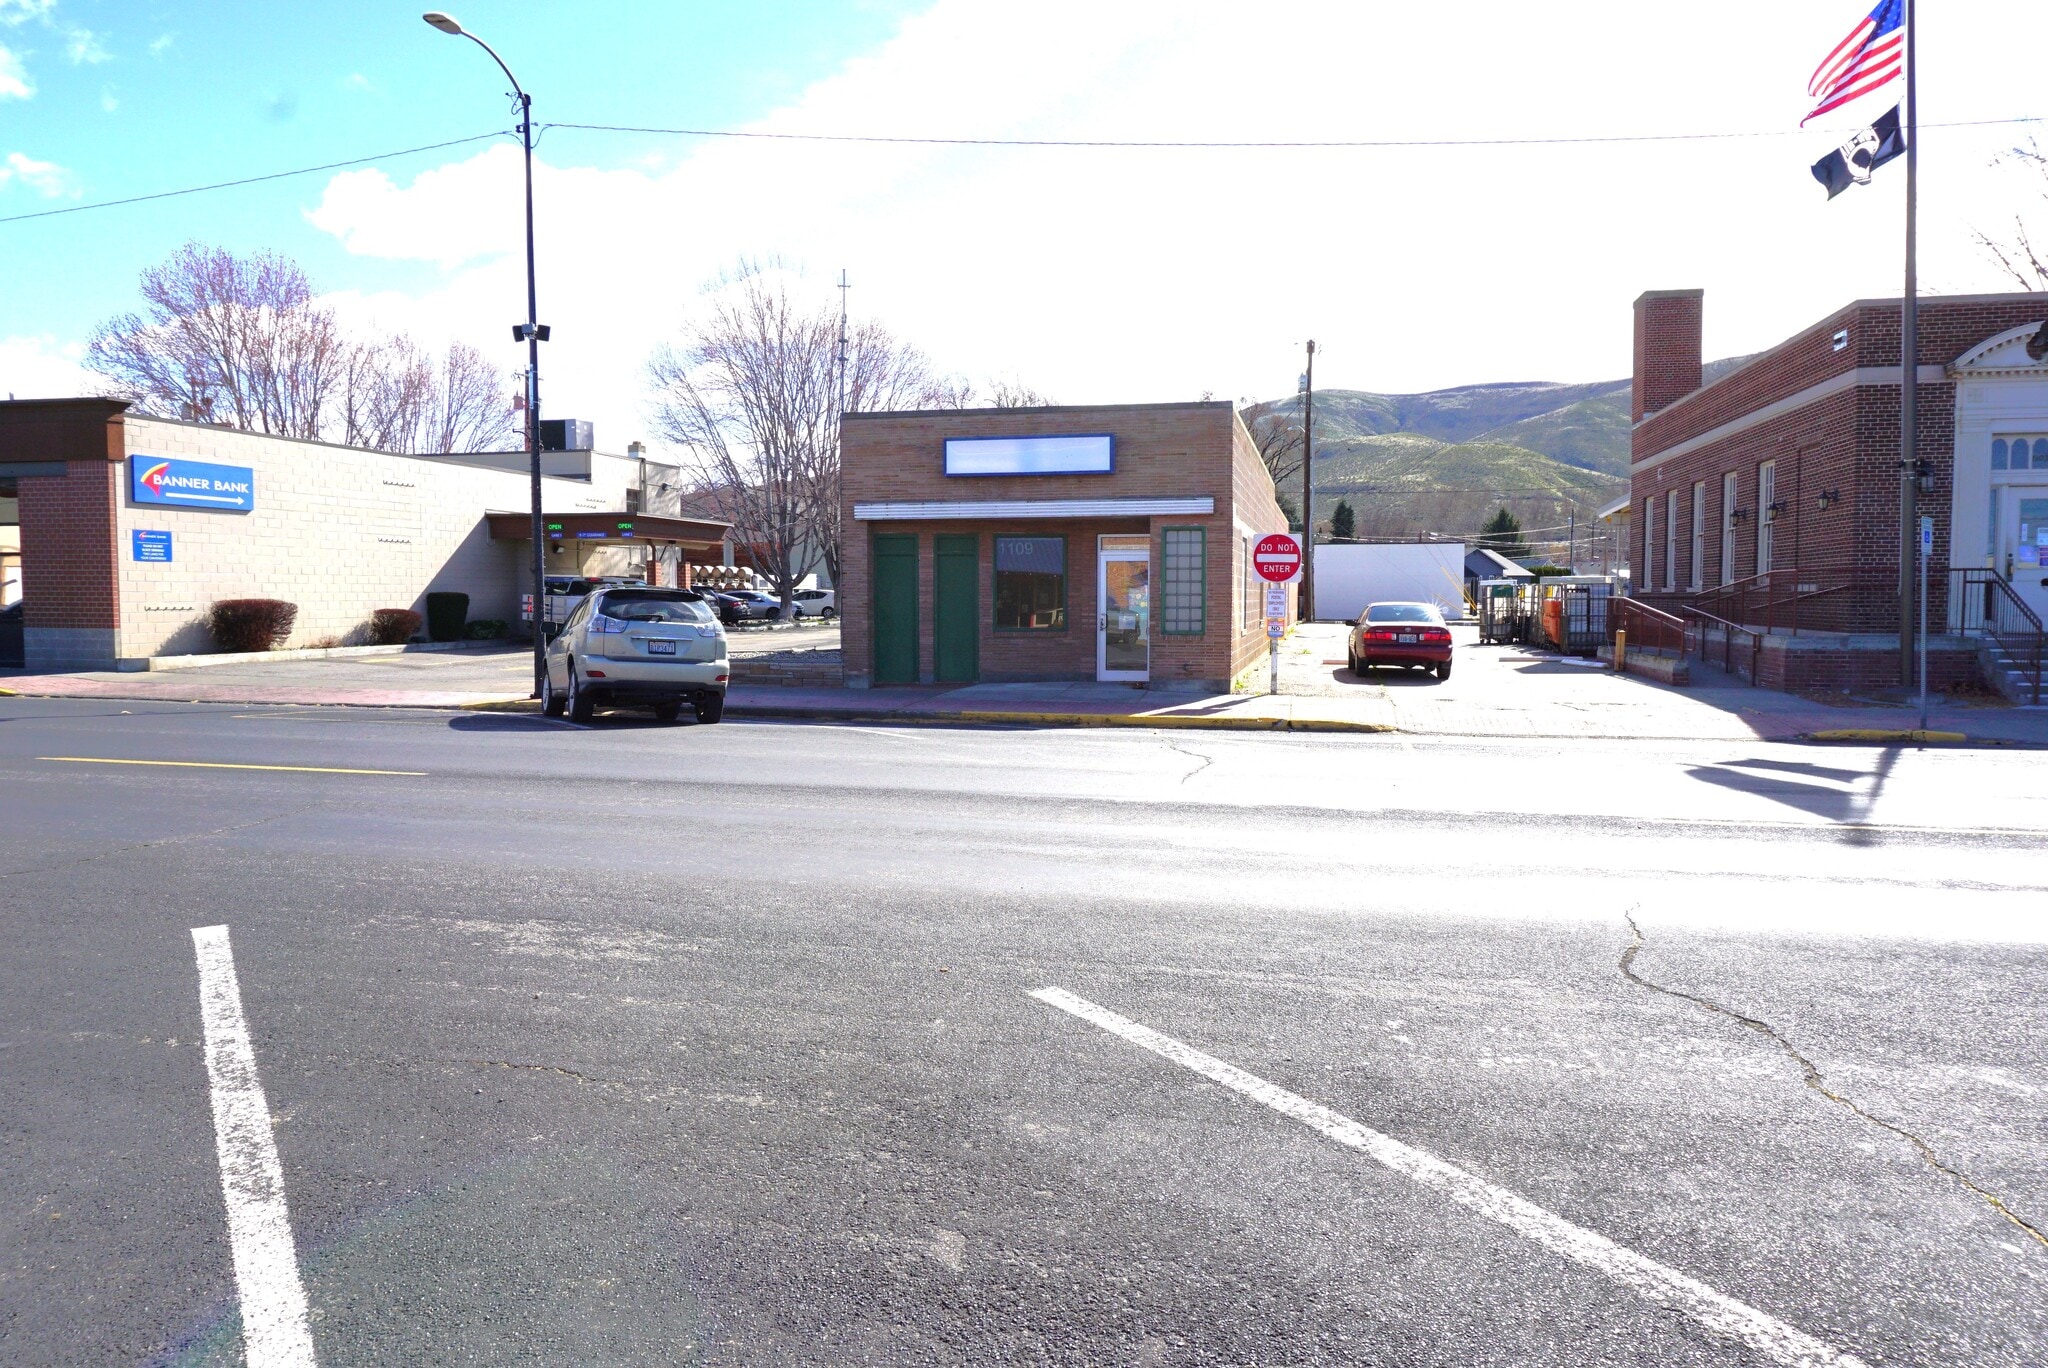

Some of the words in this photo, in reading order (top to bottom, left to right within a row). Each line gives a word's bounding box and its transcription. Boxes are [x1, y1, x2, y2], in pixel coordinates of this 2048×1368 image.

[153, 474, 210, 490] BANNER
[214, 480, 249, 494] BANK
[1000, 542, 1033, 555] 1109
[1261, 543, 1272, 552] DO
[1277, 543, 1294, 552] NOT
[1263, 564, 1290, 573] ENTER
